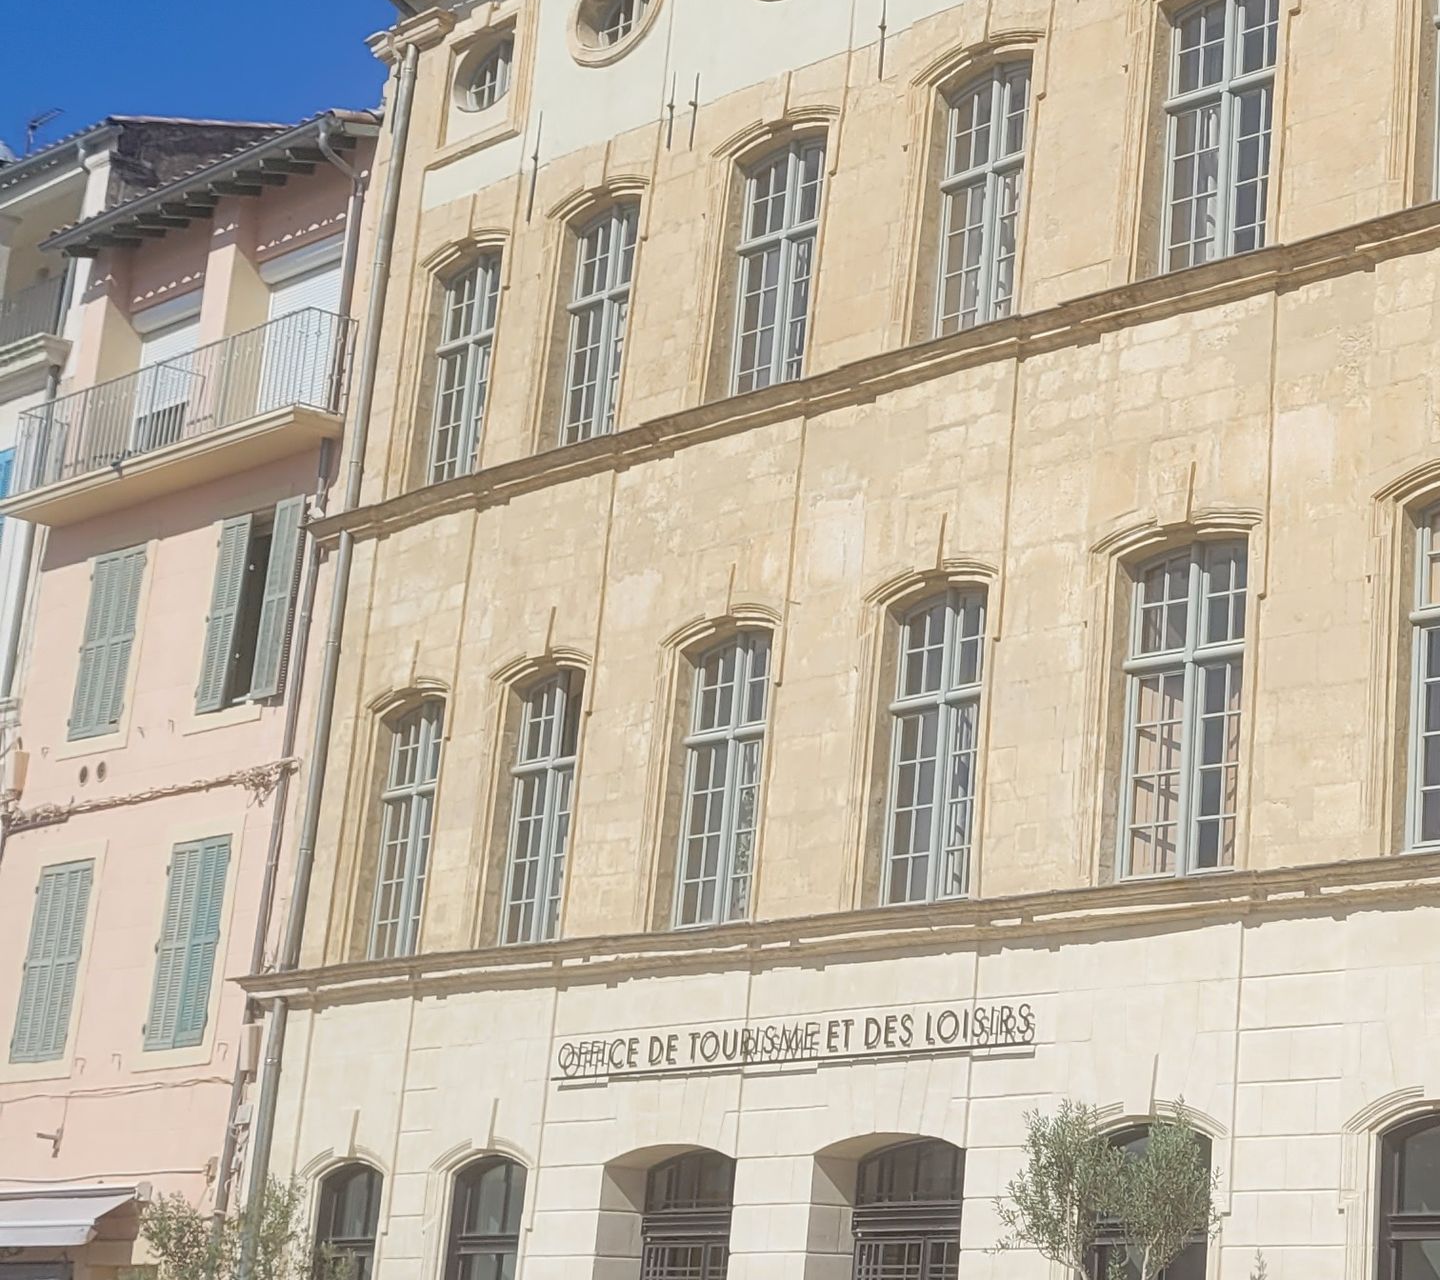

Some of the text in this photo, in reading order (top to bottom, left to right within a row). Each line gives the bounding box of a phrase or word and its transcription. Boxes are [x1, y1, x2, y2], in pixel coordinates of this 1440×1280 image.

[558, 1003, 1036, 1072] OFFICE DE TOURISME ET DES LOISIRS
